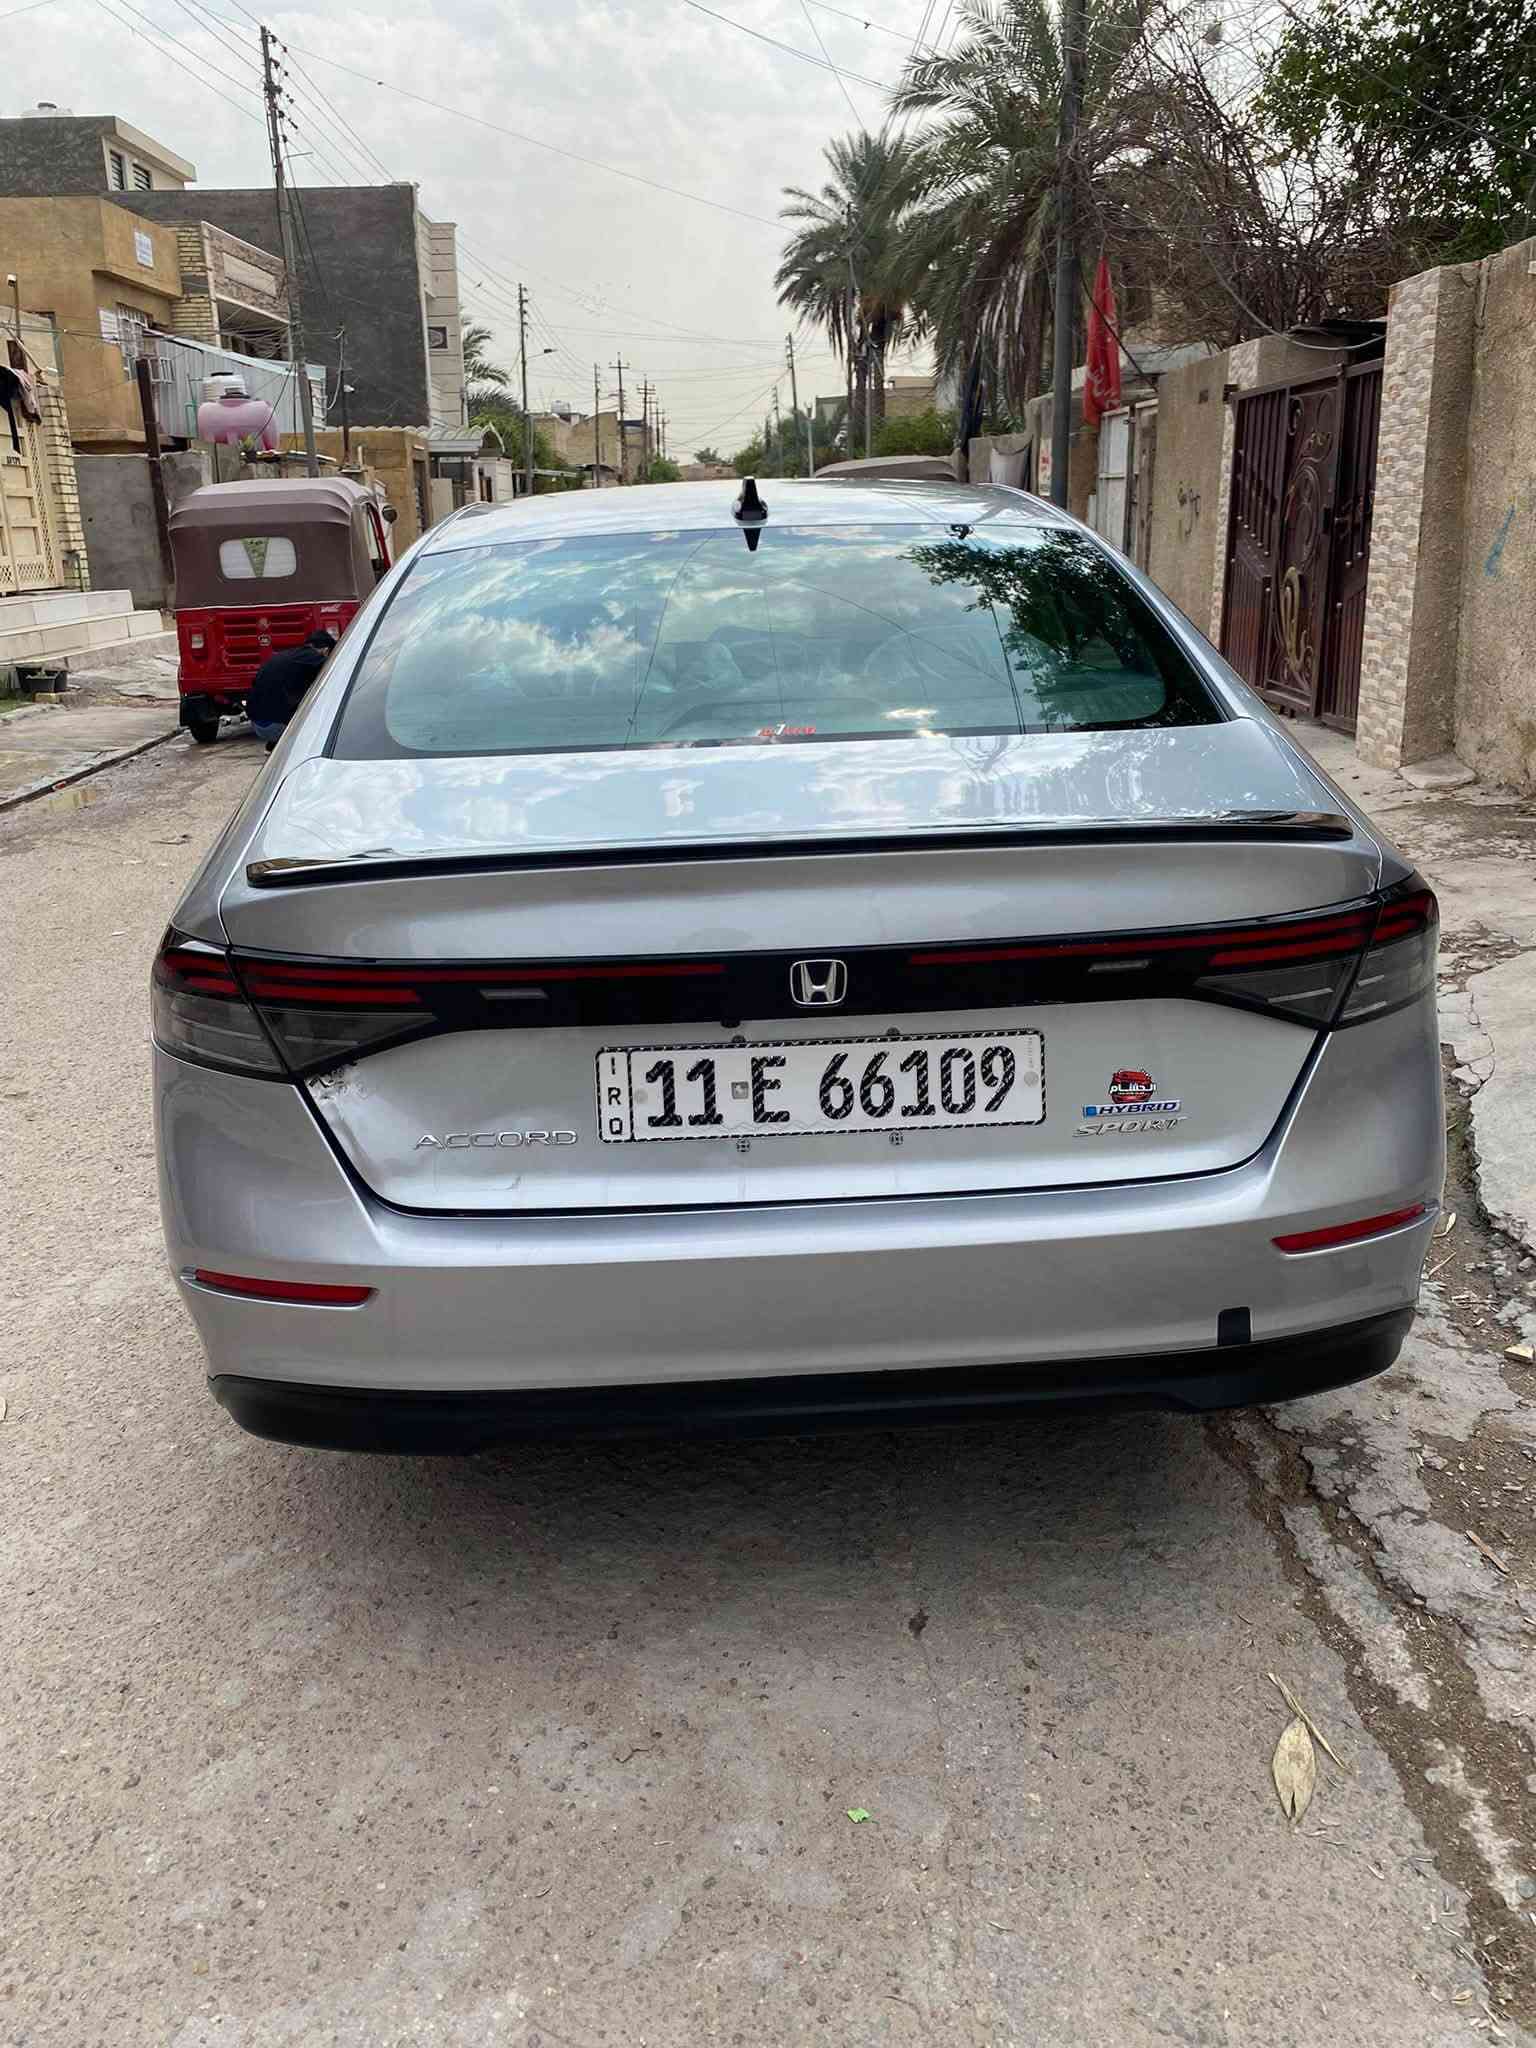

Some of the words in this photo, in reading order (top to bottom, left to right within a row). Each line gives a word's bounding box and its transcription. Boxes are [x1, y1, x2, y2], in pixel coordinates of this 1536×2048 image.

[607, 1056, 623, 1136] IRQ
[645, 1058, 724, 1128] 11
[750, 1055, 791, 1124] E
[818, 1044, 1017, 1122] 66109
[1099, 1102, 1178, 1115] HYBRID
[1072, 1116, 1189, 1138] SPORT
[413, 1129, 579, 1151] ACCORD
